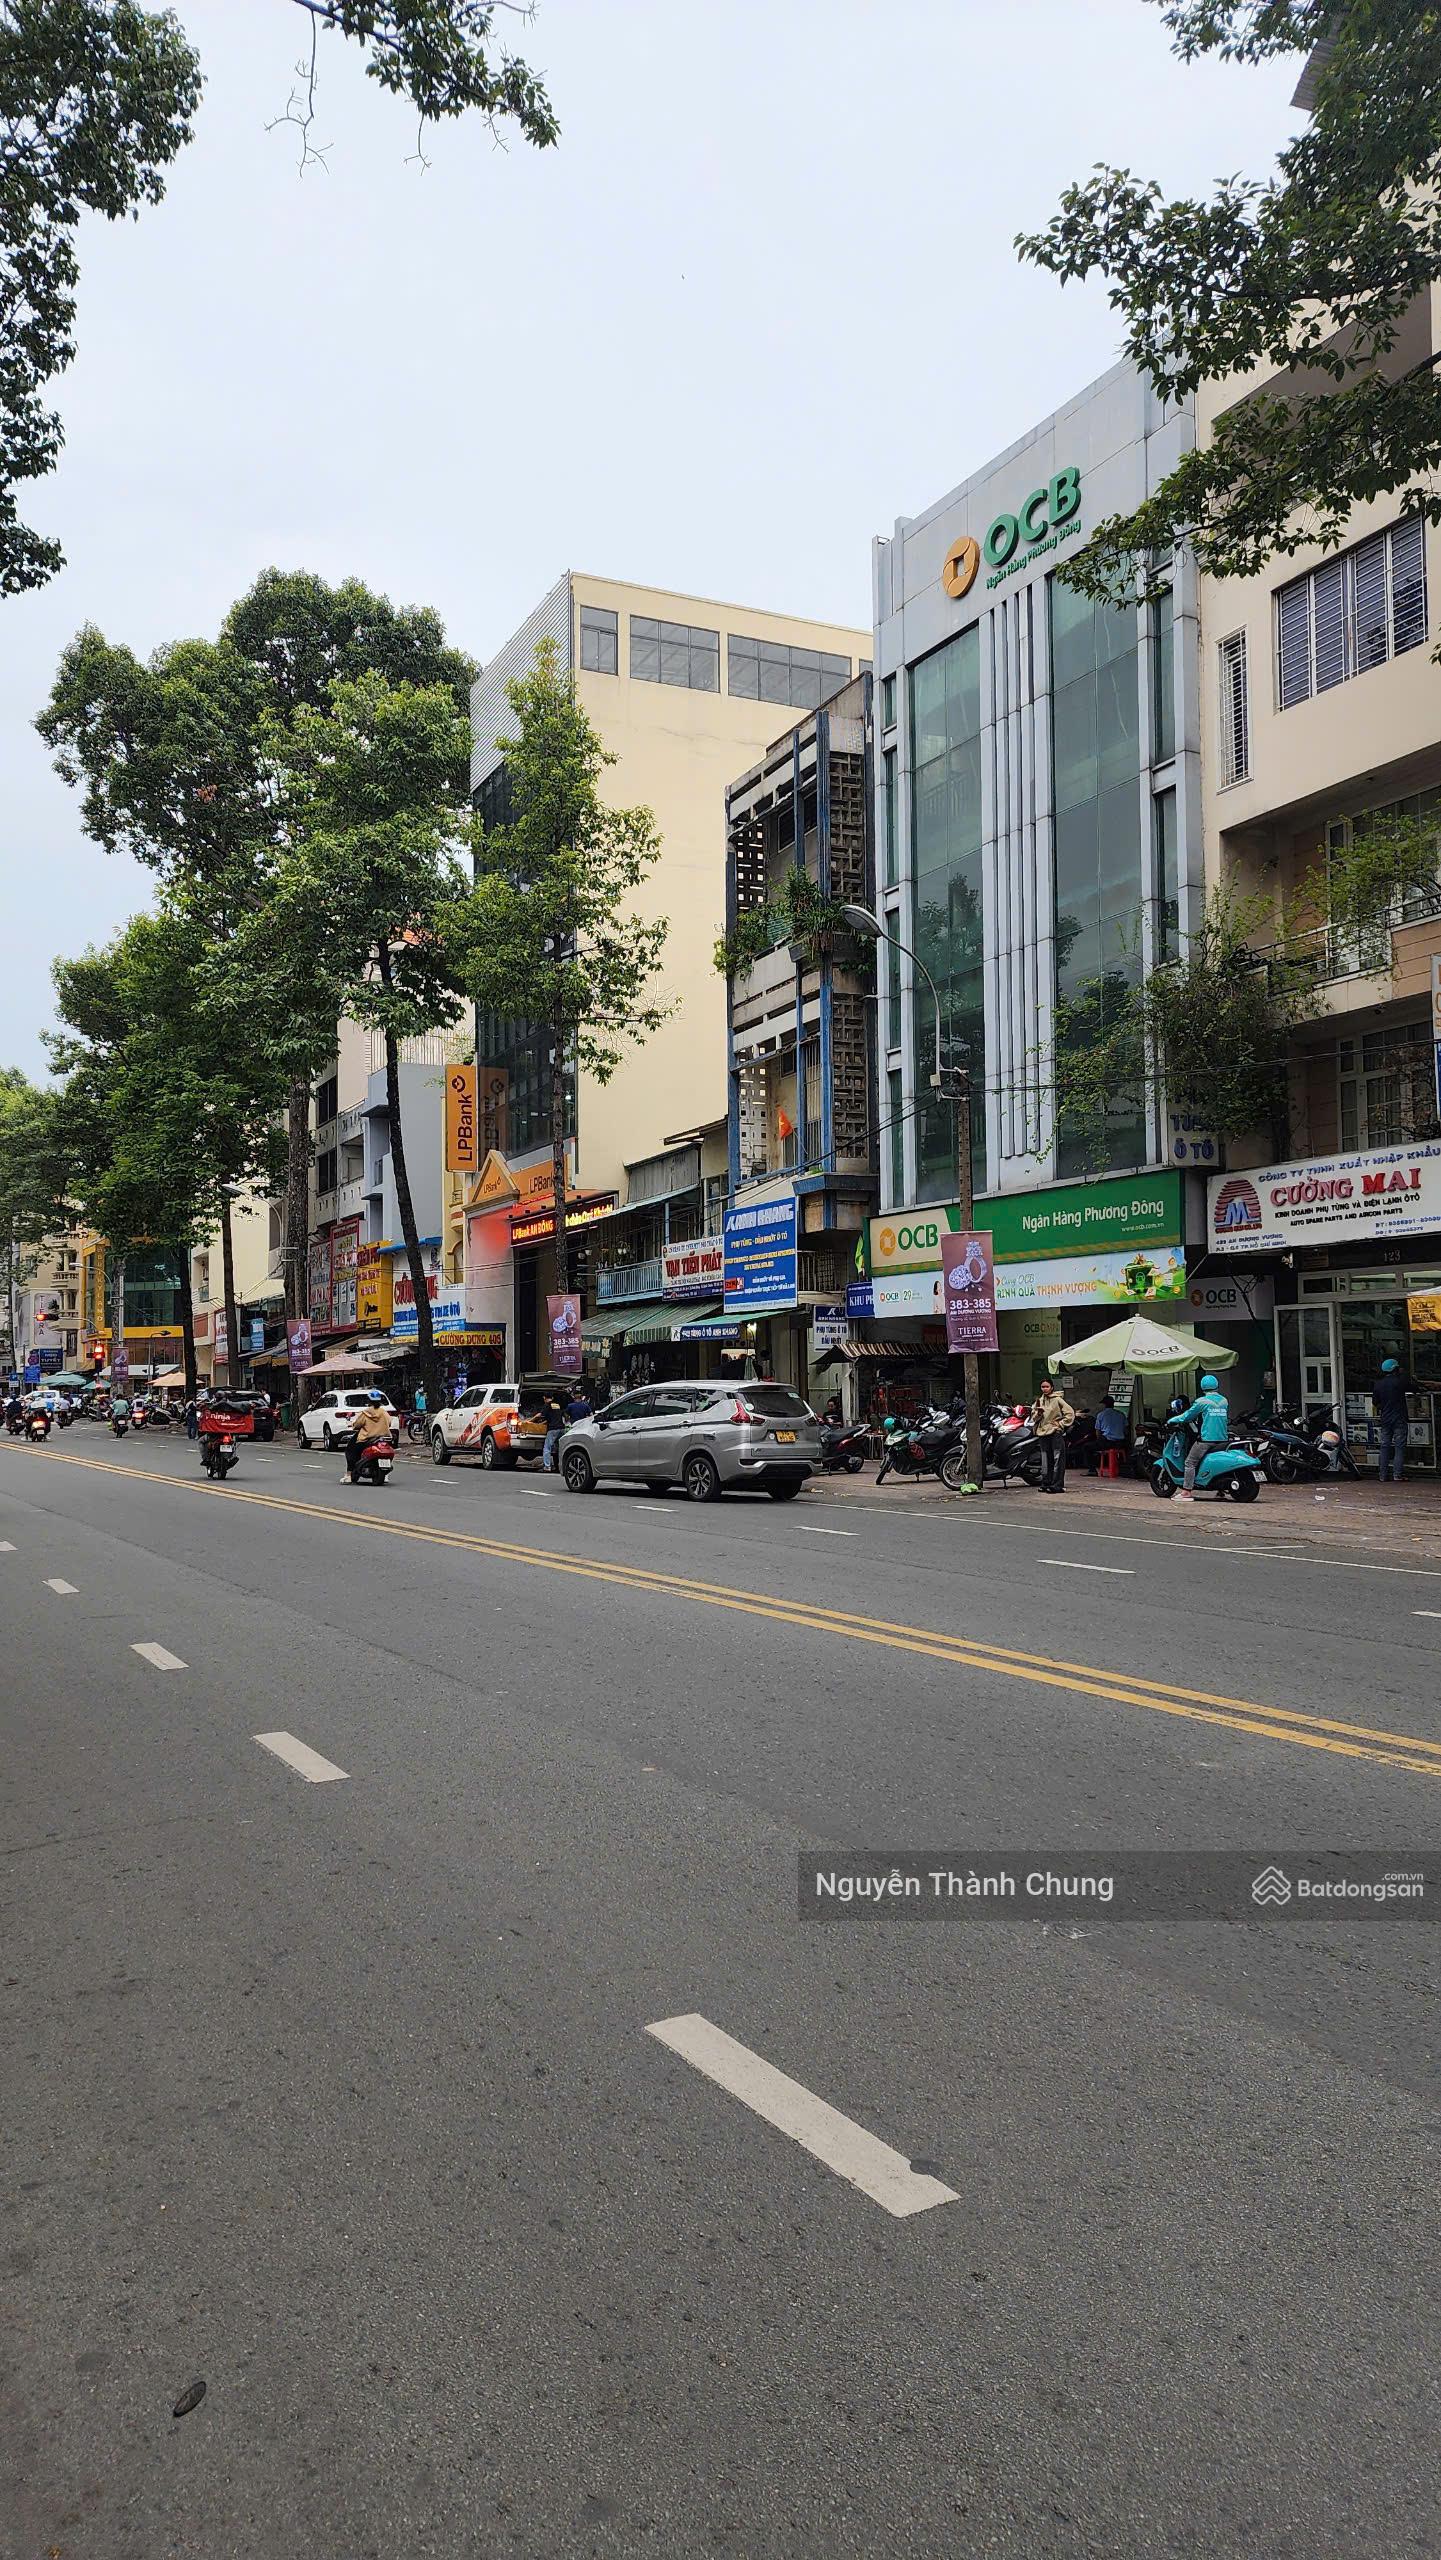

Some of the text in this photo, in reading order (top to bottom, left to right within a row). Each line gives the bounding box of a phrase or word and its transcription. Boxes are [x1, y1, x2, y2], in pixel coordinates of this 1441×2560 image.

[983, 466, 1082, 567] OCB
[457, 1093, 473, 1162] LPBank
[1258, 1172, 1287, 1184] CÔNG
[1290, 1169, 1303, 1179] TY
[1307, 1165, 1335, 1177] TNHH
[1270, 1167, 1421, 1207] CƯỜNG MAI
[1274, 1210, 1290, 1219] KINH
[1291, 1207, 1314, 1218] DOANH
[1315, 1205, 1329, 1215] PHỤ
[1331, 1200, 1350, 1212] TÙNG
[1352, 1198, 1362, 1209] VÀ
[1382, 1195, 1403, 1207] LẠNH
[1404, 1192, 1421, 1203] ÔTÔ
[1022, 1199, 1164, 1233] Ngân Hàng Phương Đông
[1290, 1207, 1403, 1227] AUTO SPARE PARTS AND AIRCON PARTS
[897, 1223, 938, 1251] OCB
[885, 1292, 899, 1301] OCB
[1036, 1283, 1064, 1297] THỊNH
[1065, 1279, 1097, 1294] VƯỢNG
[1205, 1288, 1237, 1304] OCB
[849, 1294, 864, 1307] KHU
[950, 1298, 992, 1310] 383-385
[440, 1332, 465, 1345] CƯỜNG
[958, 1326, 987, 1335] TIERRA
[553, 1337, 580, 1346] 383-385
[1147, 1345, 1181, 1357] OCB
[210, 1412, 231, 1422] ninja
